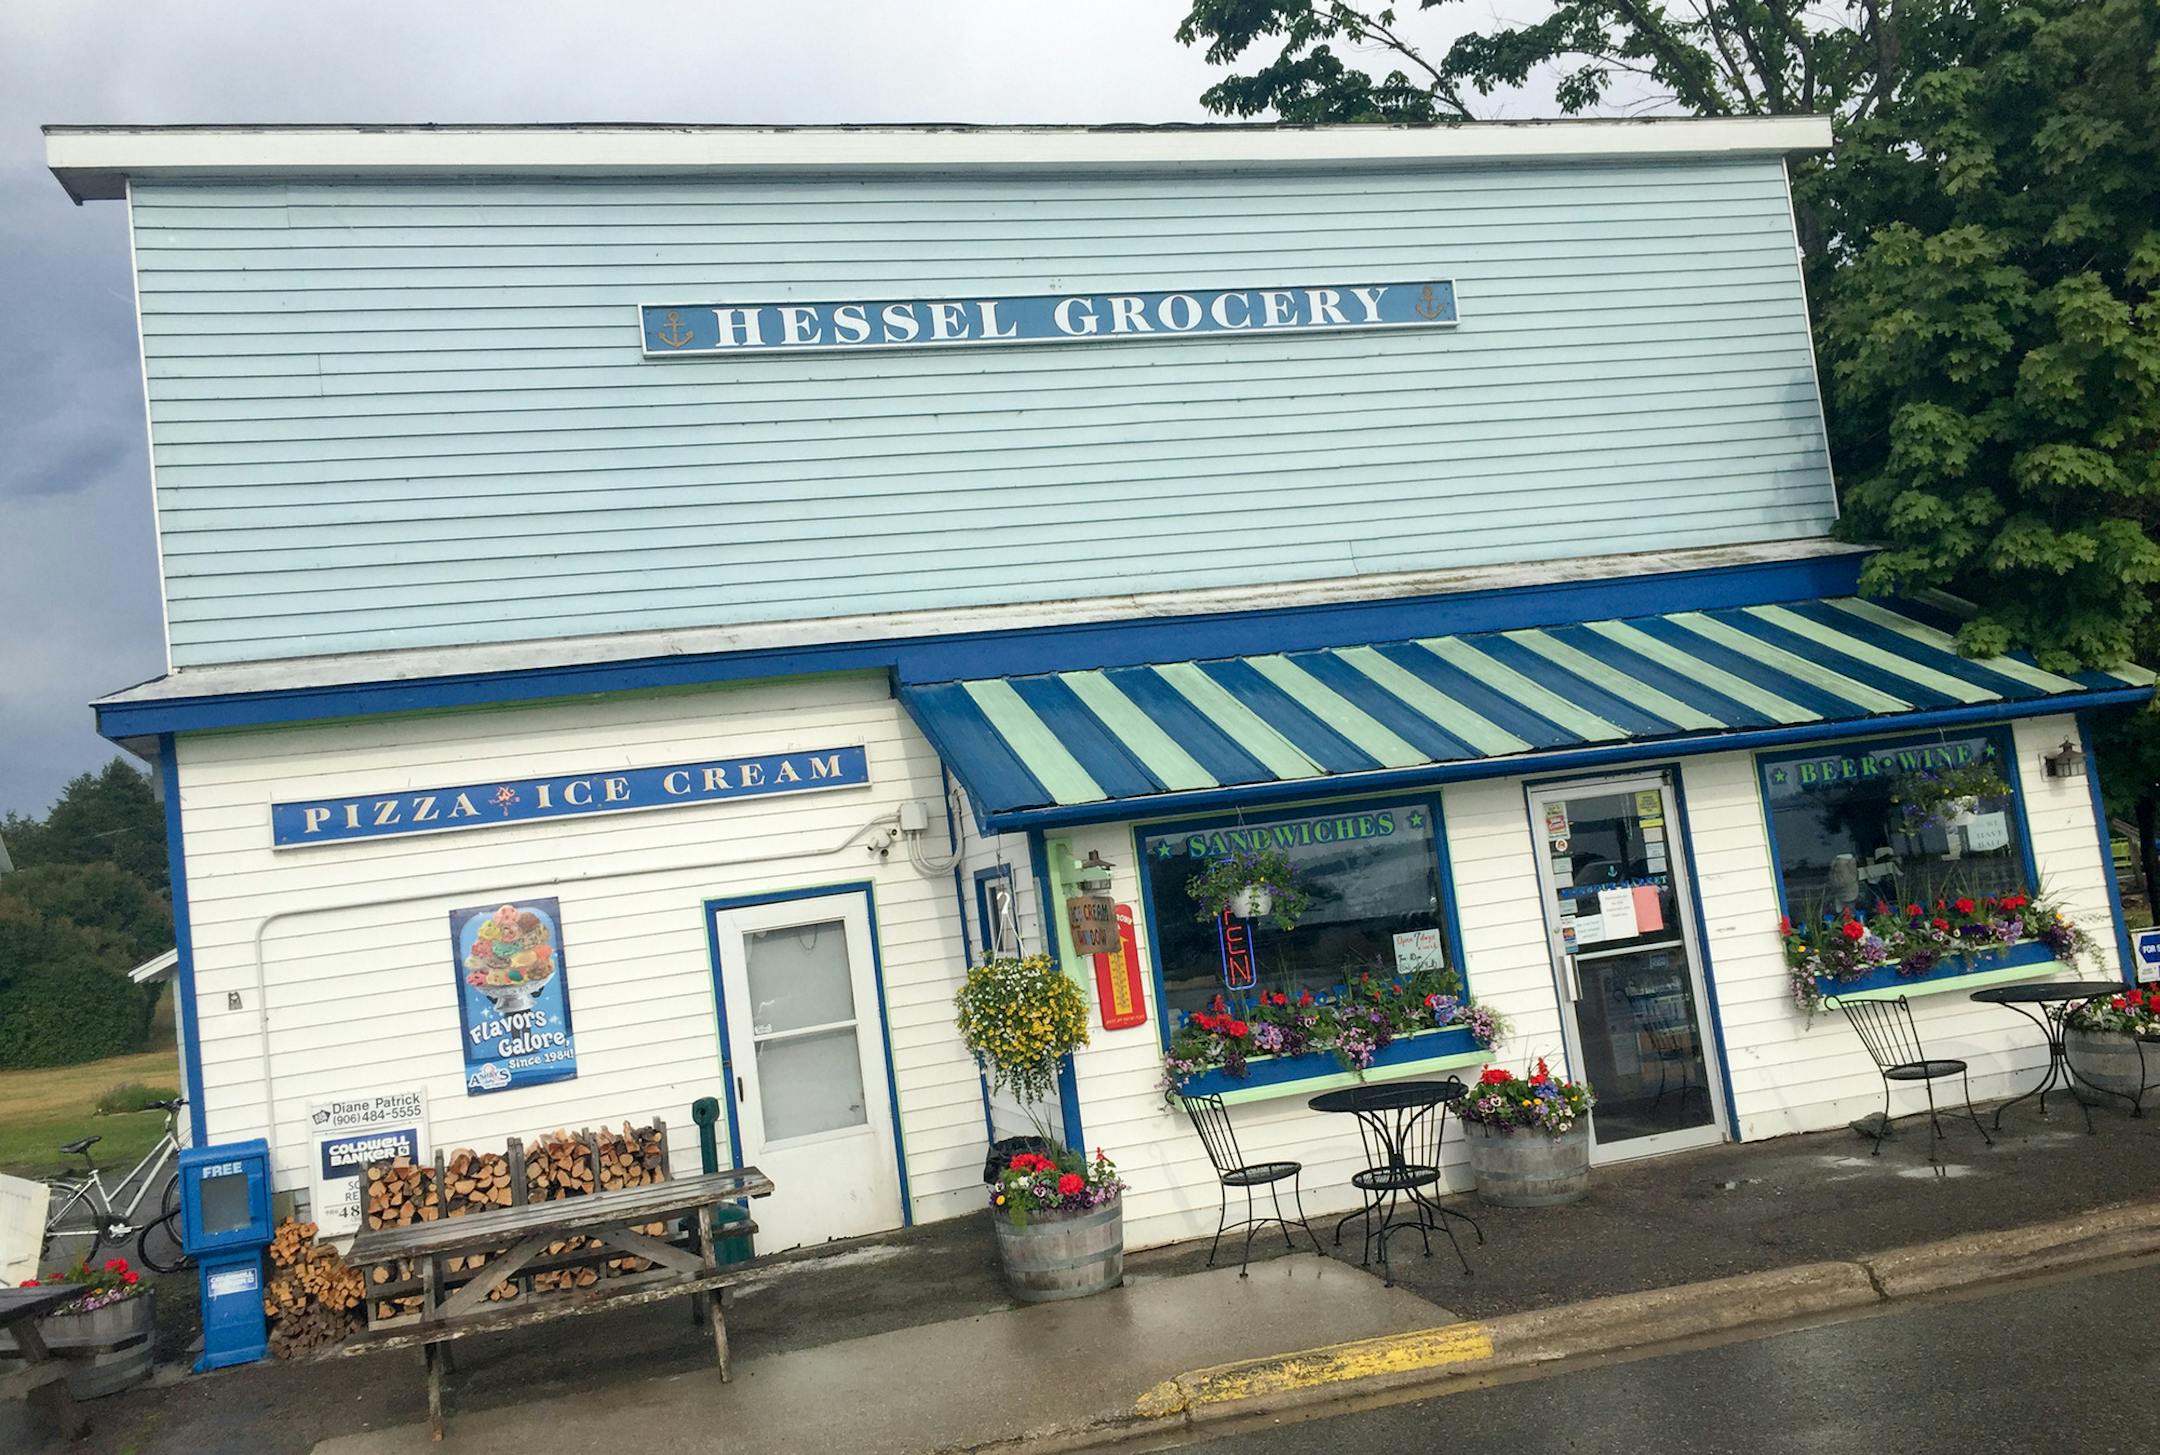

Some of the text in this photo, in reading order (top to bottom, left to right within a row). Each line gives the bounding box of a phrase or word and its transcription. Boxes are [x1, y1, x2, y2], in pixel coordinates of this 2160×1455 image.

[712, 286, 1390, 347] HESSEL GROCERY
[1799, 743, 1971, 785] BEER WINE
[303, 754, 843, 834] PIZZA ICE CREAM
[1186, 810, 1396, 859] SANDWICHES
[1084, 903, 1110, 921] CREAM
[2142, 944, 2156, 954] FOR
[469, 1009, 548, 1046] Flavors
[498, 1031, 571, 1058] Galore,
[543, 1049, 574, 1064] 1984!
[332, 1093, 421, 1115] Diane Patrick
[328, 1135, 410, 1156] COLDWELL
[330, 1147, 395, 1167] BANKER
[202, 1161, 243, 1179] FREE
